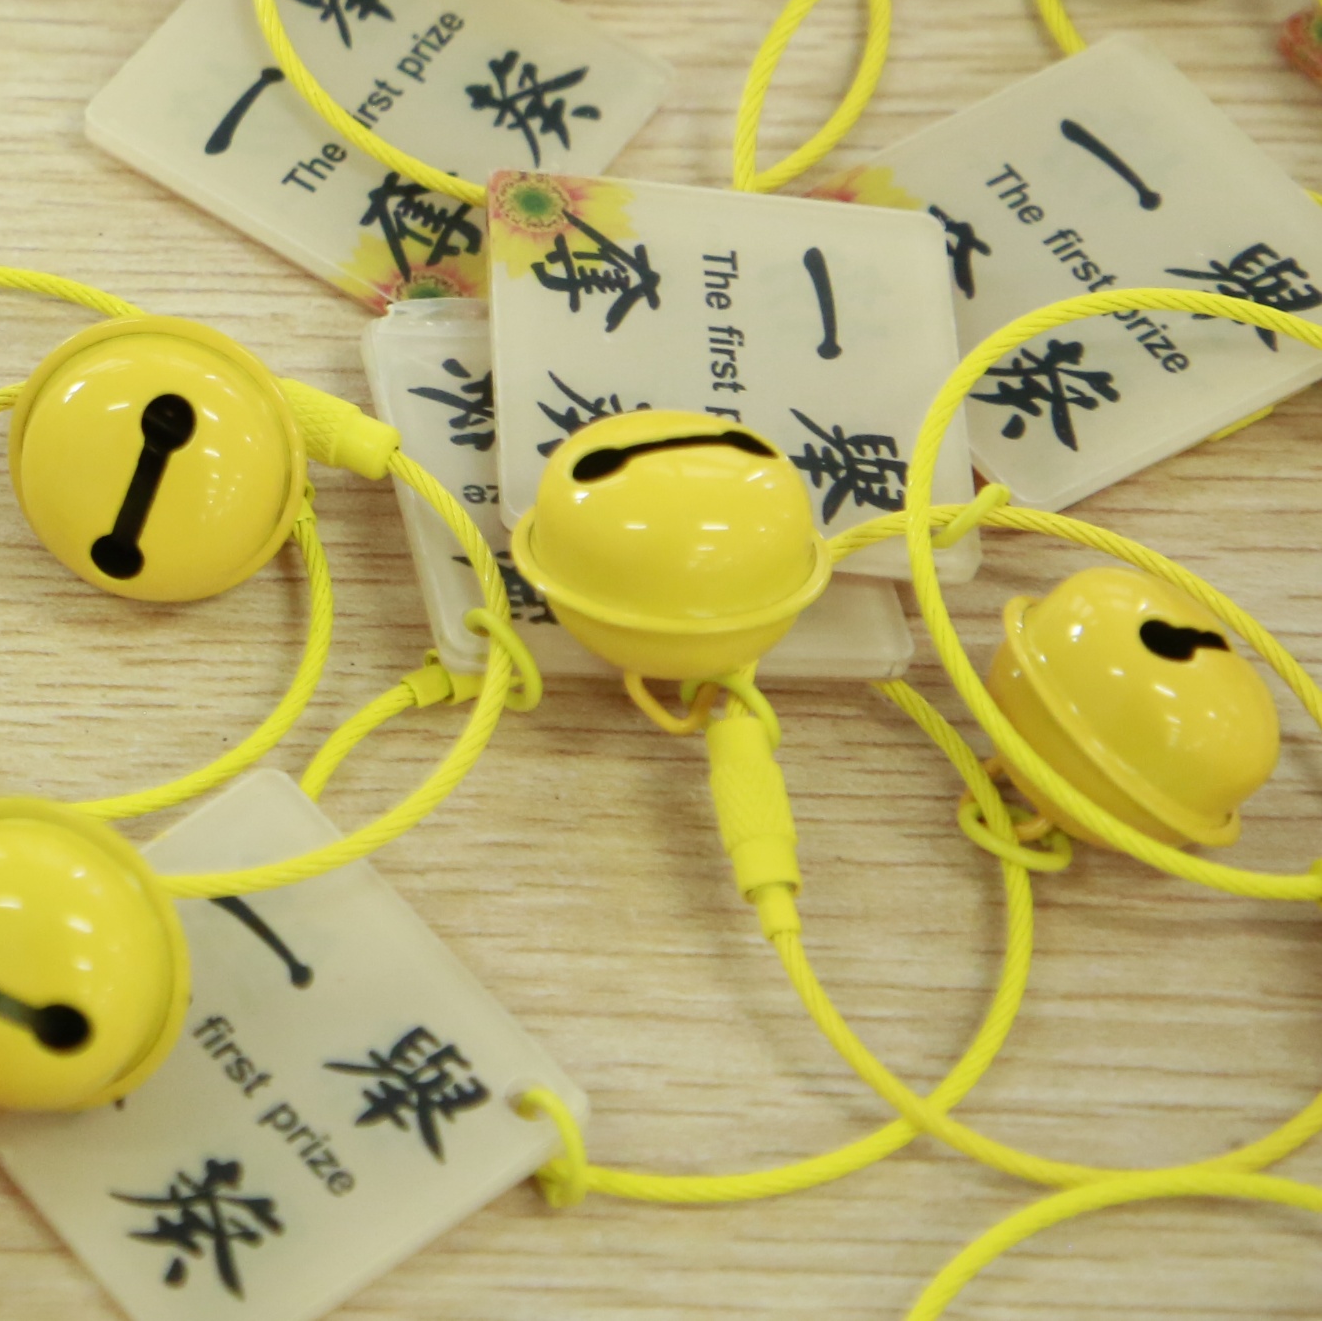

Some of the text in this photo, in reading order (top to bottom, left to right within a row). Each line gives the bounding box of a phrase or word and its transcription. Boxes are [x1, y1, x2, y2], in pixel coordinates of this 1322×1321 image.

[281, 9, 465, 194] The irst prize
[702, 250, 741, 311] The
[984, 164, 1046, 226] The
[1043, 227, 1119, 294] first
[707, 325, 747, 394] first
[191, 1013, 356, 1198] first prize
